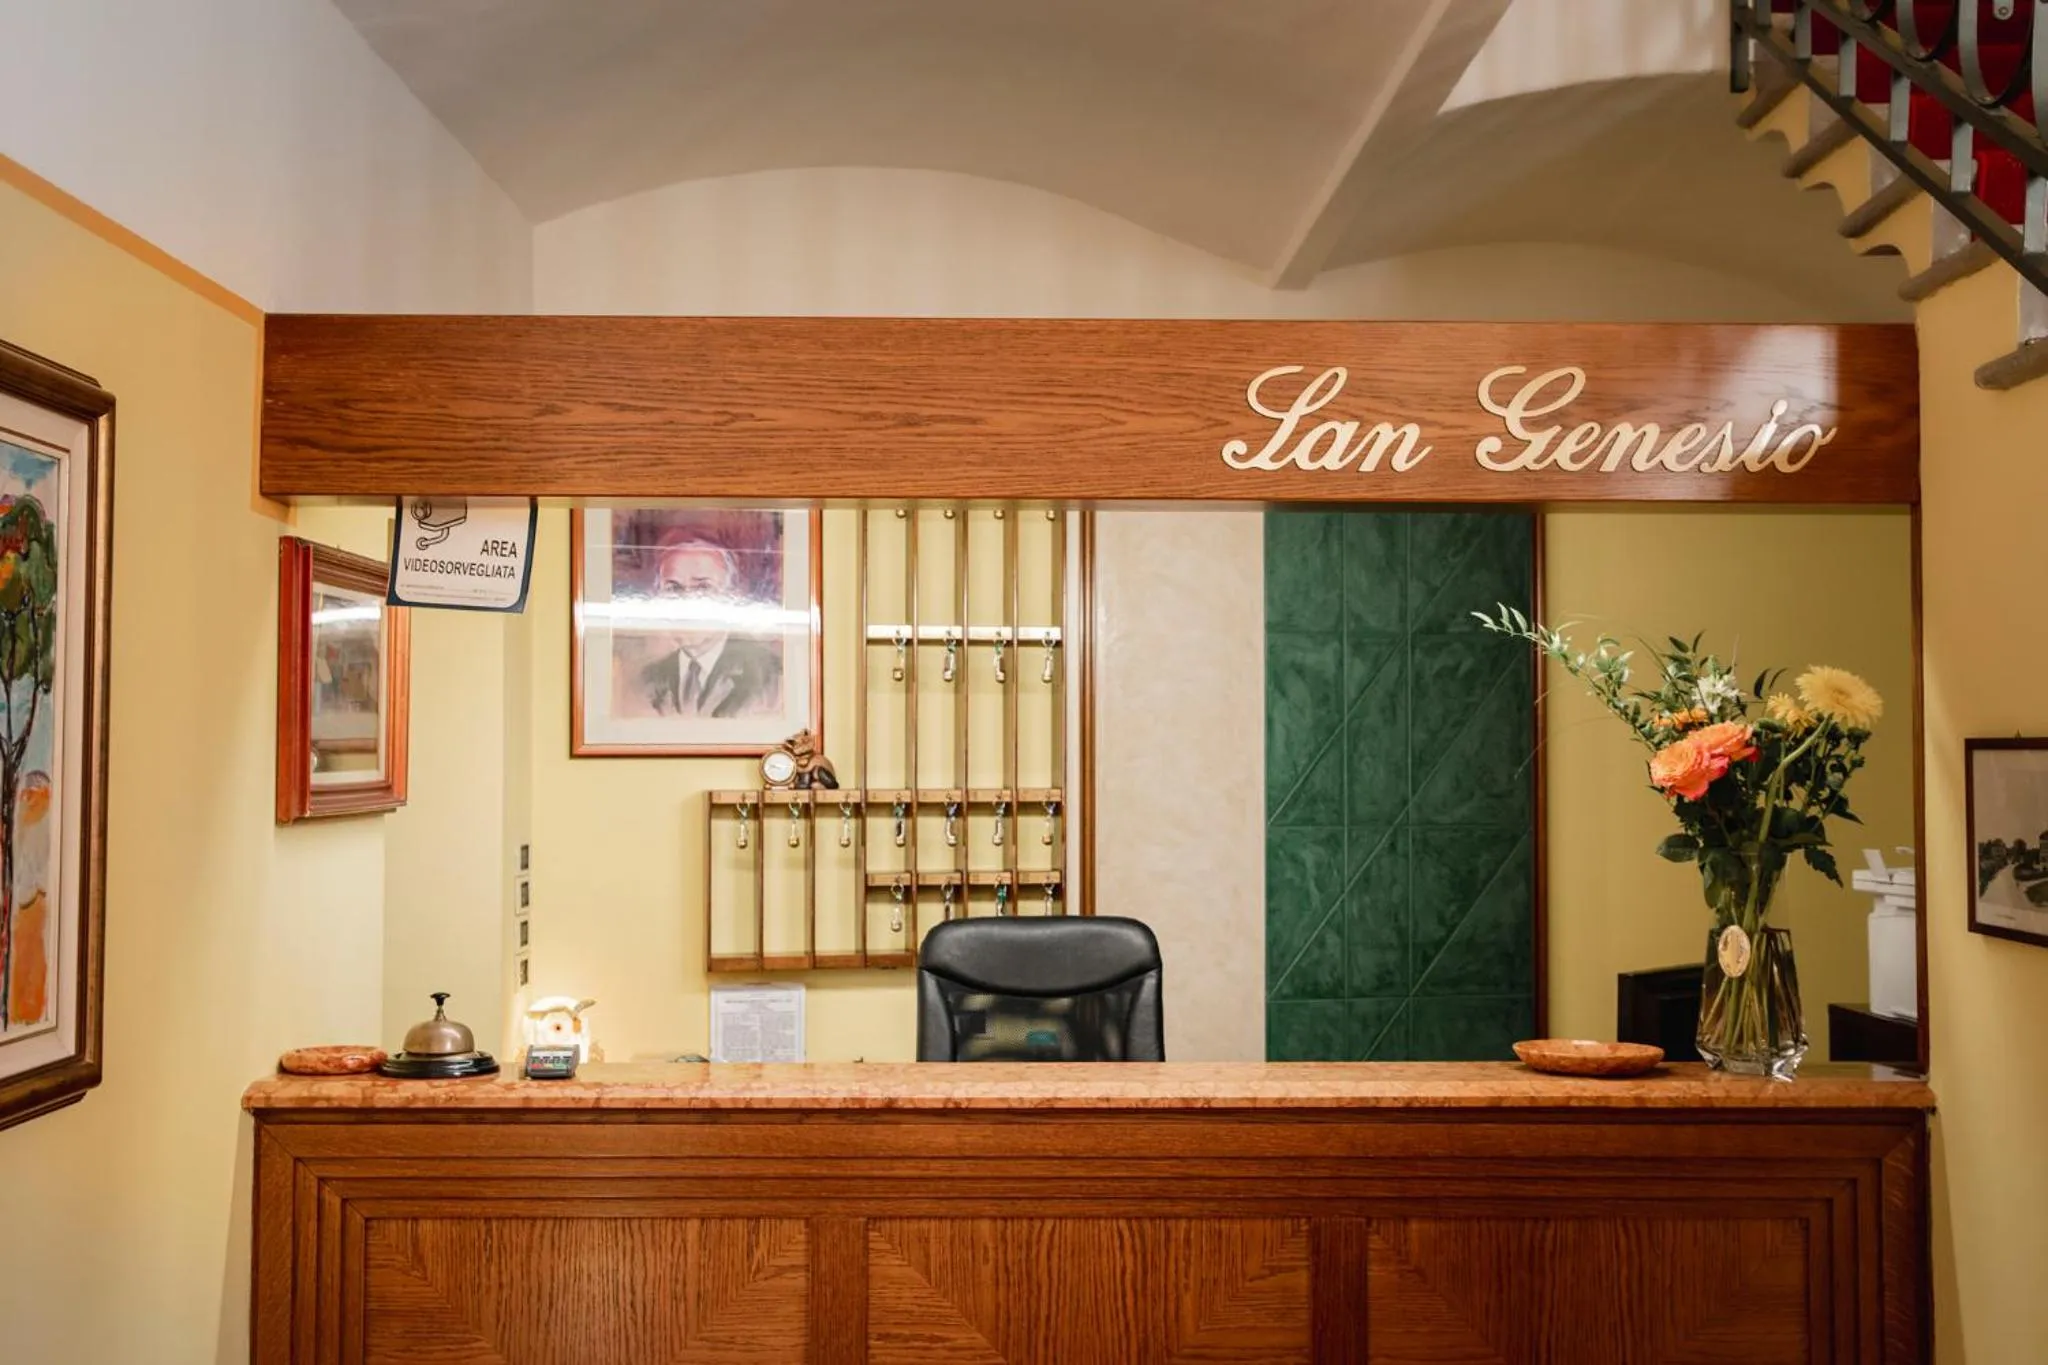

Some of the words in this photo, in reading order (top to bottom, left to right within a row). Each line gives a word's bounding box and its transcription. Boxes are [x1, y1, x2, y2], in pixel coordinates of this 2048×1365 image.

[1475, 365, 1837, 474] Genesio
[480, 540, 517, 558] AREA
[403, 558, 515, 579] VIDEOSORVEGLIATA
